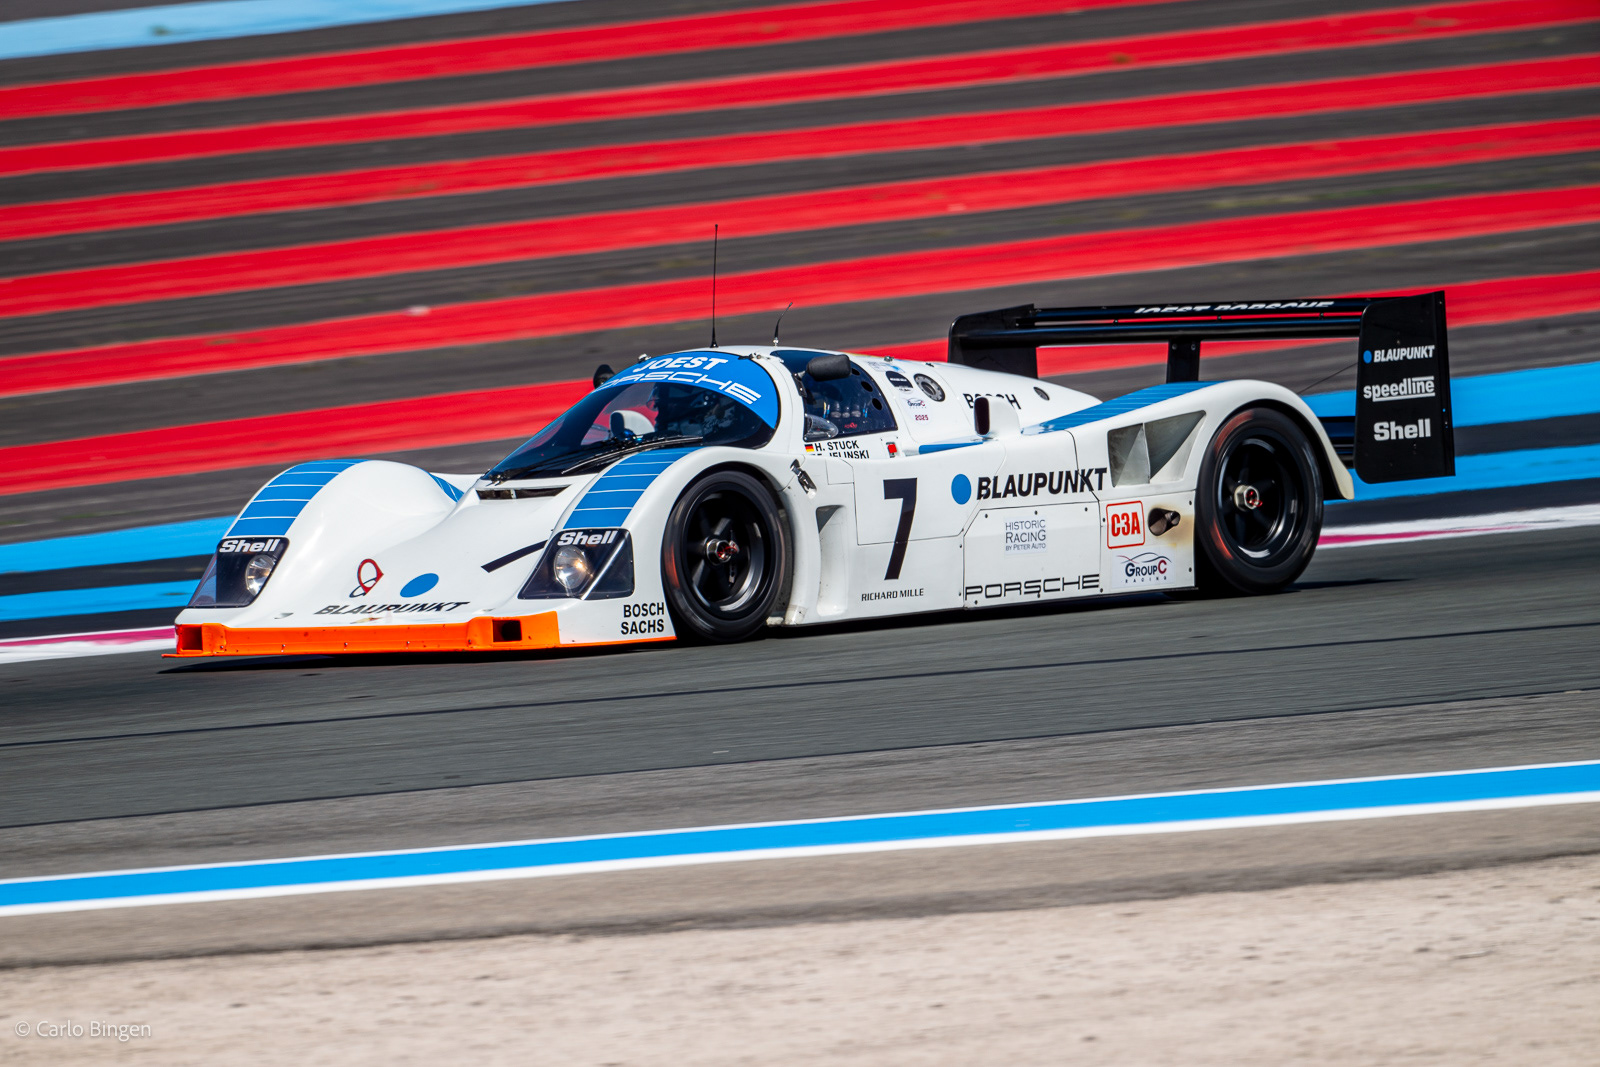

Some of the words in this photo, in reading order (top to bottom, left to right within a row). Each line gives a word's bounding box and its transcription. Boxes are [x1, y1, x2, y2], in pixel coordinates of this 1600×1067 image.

[1373, 345, 1435, 363] BLAUPUNKT
[632, 356, 728, 373] JOEST
[1363, 376, 1436, 402] speedline
[1373, 418, 1431, 442] Shell
[814, 442, 826, 452] H.
[827, 440, 860, 450] STUCK
[976, 468, 1107, 500] BLAUPUNKT
[883, 477, 918, 581] 7
[1005, 519, 1046, 531] HISTORIC
[1111, 511, 1141, 537] C3A
[557, 530, 618, 546] Shell
[1005, 529, 1047, 544] RACING
[219, 538, 281, 553] Shell
[861, 590, 898, 602] RICHARD
[899, 587, 925, 598] MILLE
[964, 574, 1101, 600] PORSCHE
[313, 601, 471, 616] BLAUPUNKT
[623, 602, 665, 618] BOSCH
[620, 619, 665, 635] SACHS
